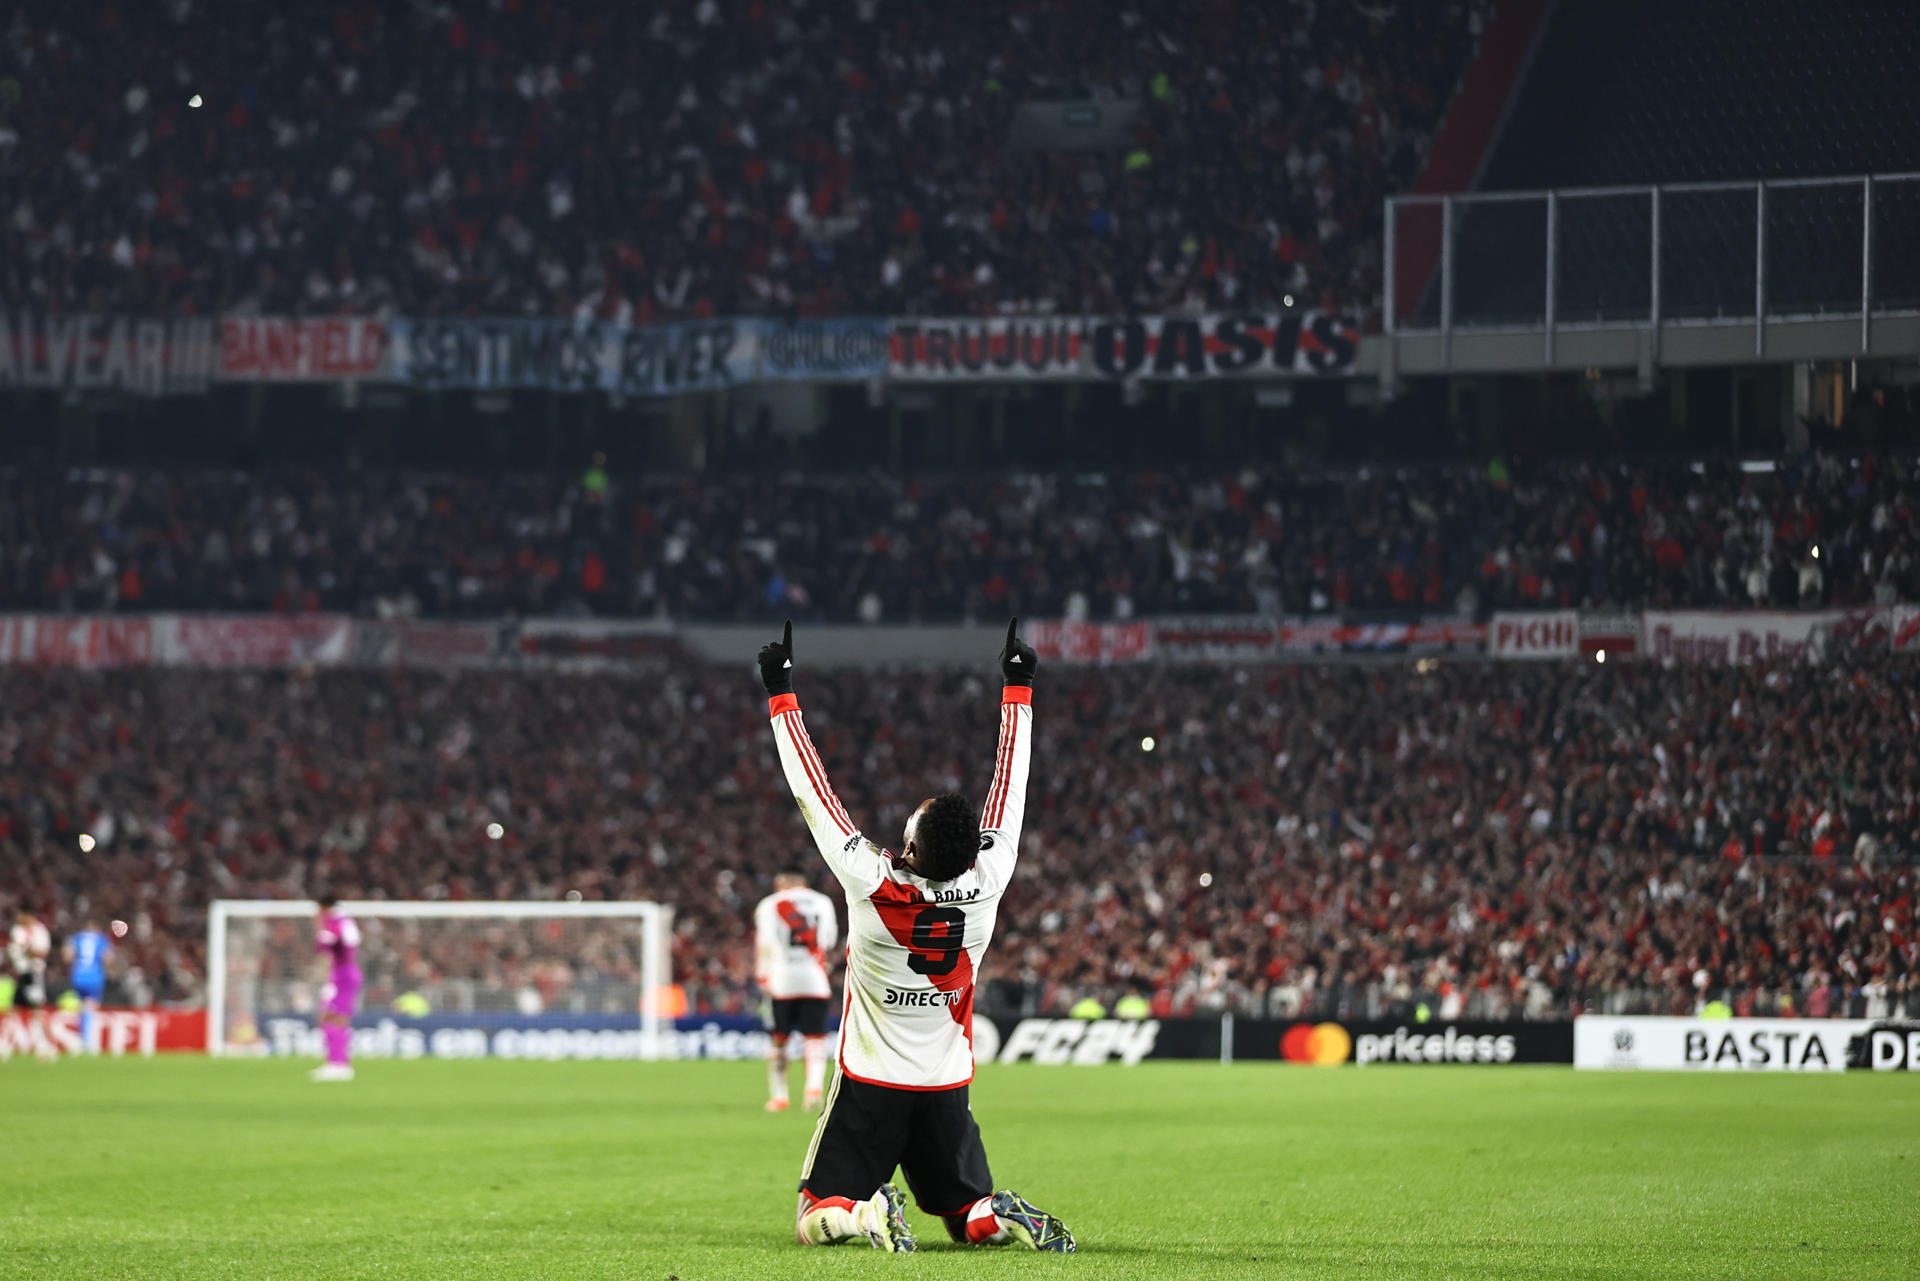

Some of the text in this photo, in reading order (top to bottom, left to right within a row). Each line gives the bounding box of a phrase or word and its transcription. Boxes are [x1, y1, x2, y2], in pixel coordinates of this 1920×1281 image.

[1094, 315, 1358, 379] OASIS
[907, 906, 966, 976] 9
[267, 1017, 427, 1060] Ticets
[1356, 1026, 1516, 1067] priceless
[1684, 1030, 1830, 1065] BASTA
